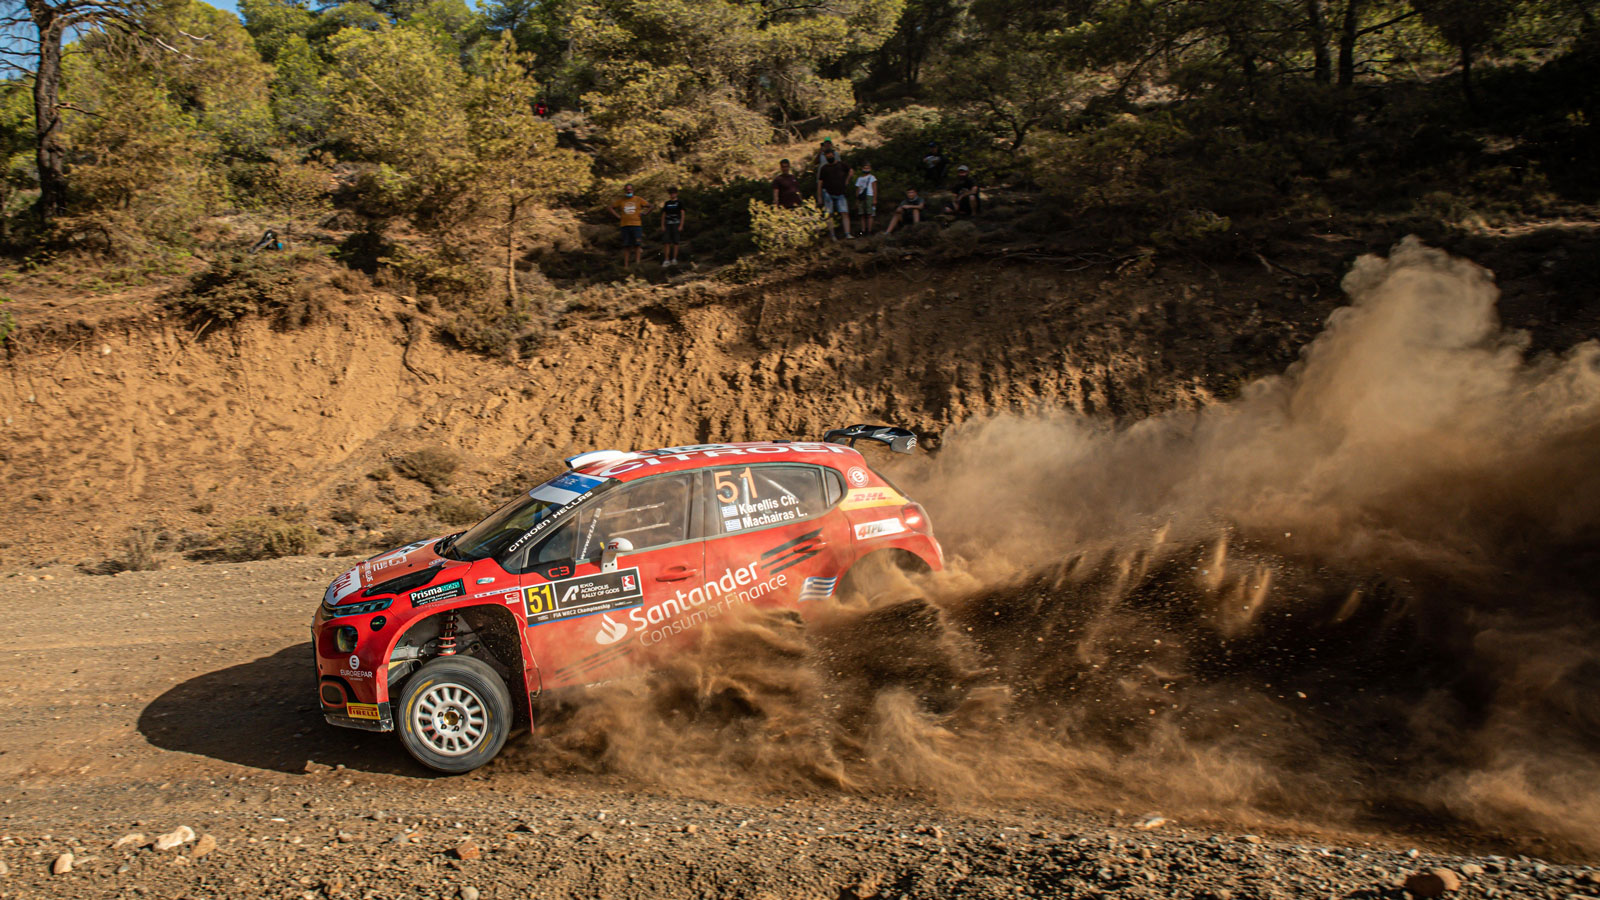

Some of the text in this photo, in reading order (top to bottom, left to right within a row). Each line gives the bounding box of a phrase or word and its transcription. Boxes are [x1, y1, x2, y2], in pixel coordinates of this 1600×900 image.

[714, 467, 758, 503] 51
[853, 492, 886, 502] DHL
[552, 490, 593, 519] HELLAS
[738, 495, 799, 515] Karellis Ch.
[741, 506, 808, 528] Machairas L.
[548, 566, 570, 577] C3
[504, 592, 520, 600] C3
[580, 584, 609, 594] ACROPOLIS
[605, 587, 620, 595] GODS
[527, 584, 554, 614] 51
[630, 562, 757, 632] Santander
[562, 609, 576, 617] WRC2
[577, 603, 611, 615] Championship
[640, 574, 788, 647] Consumer Finance
[340, 669, 373, 679] EUROREPAR
[348, 705, 378, 717] PIRELLI
